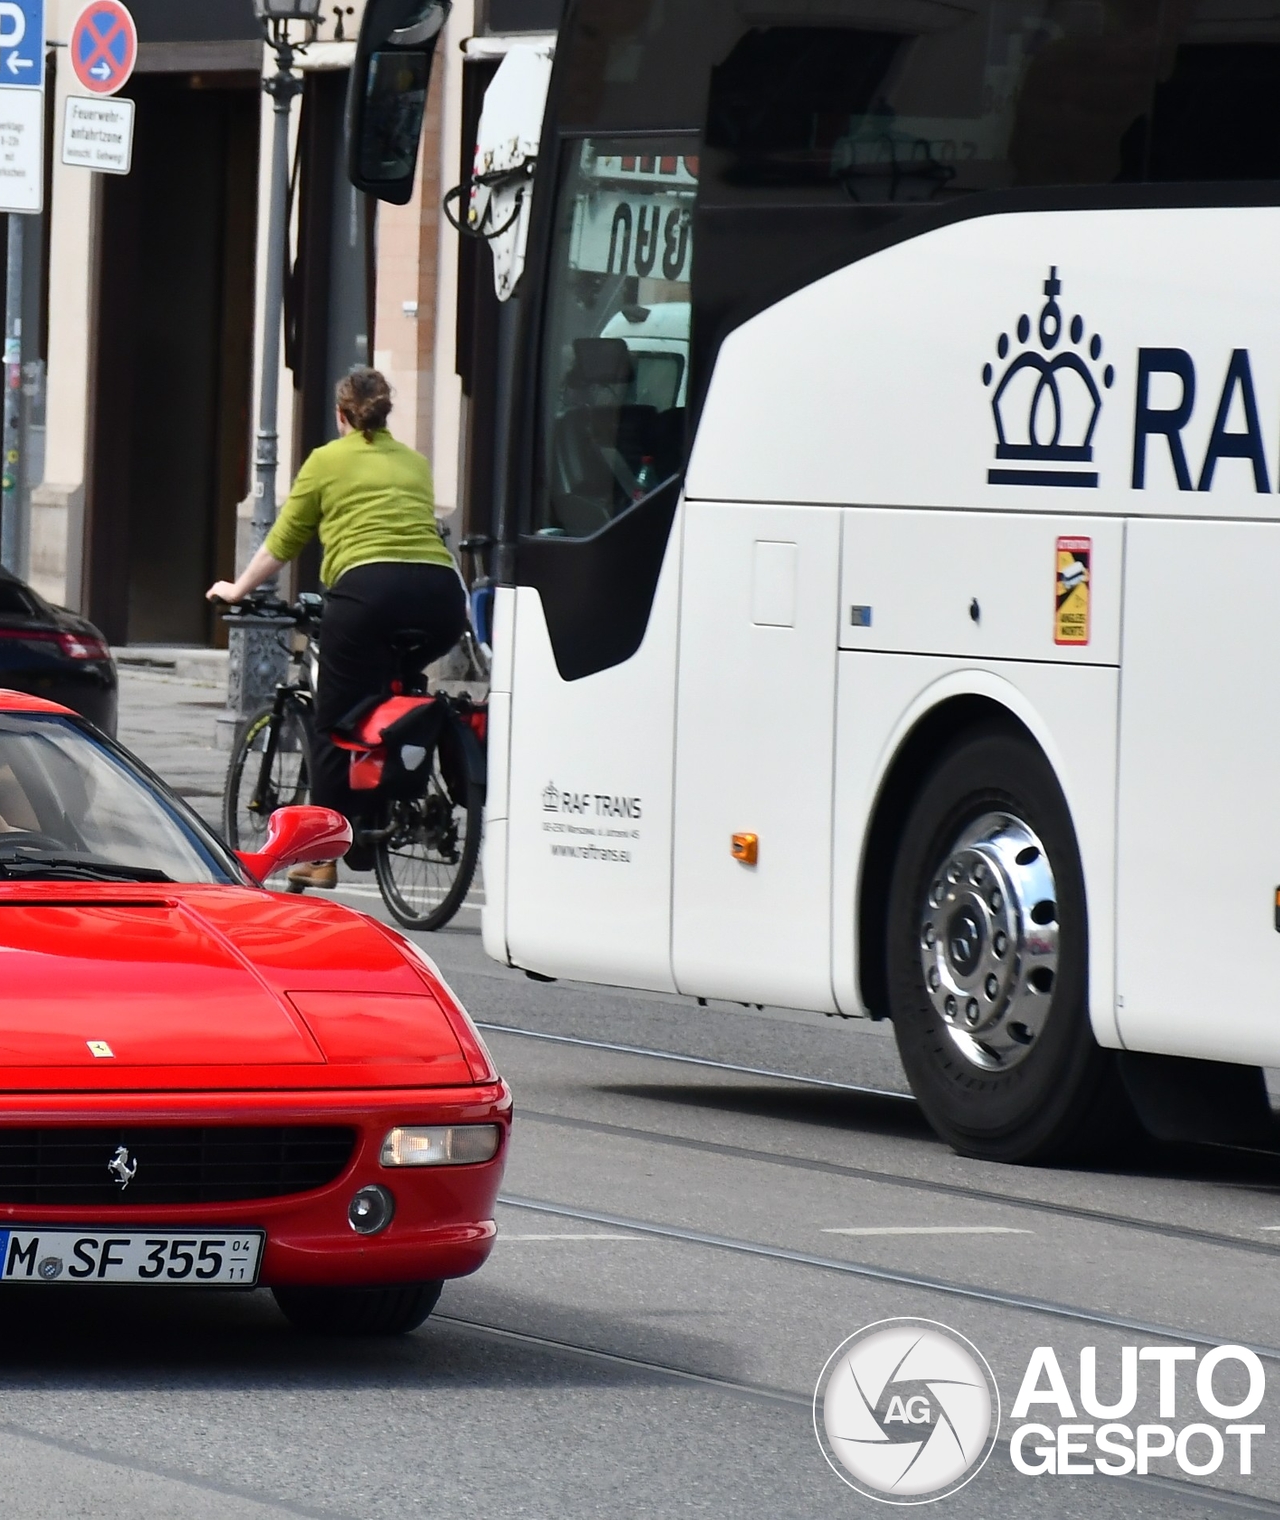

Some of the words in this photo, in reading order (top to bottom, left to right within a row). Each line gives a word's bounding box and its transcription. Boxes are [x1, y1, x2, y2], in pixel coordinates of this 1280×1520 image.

[72, 105, 124, 124] Feuerwehr-
[71, 126, 123, 145] anfahrtzone
[562, 791, 590, 814] RAF
[594, 794, 642, 819] TRANS
[232, 1240, 251, 1253] 04
[6, 1237, 40, 1277] M
[68, 1239, 131, 1278] SF
[138, 1240, 225, 1279] 355
[228, 1267, 245, 1280] 11
